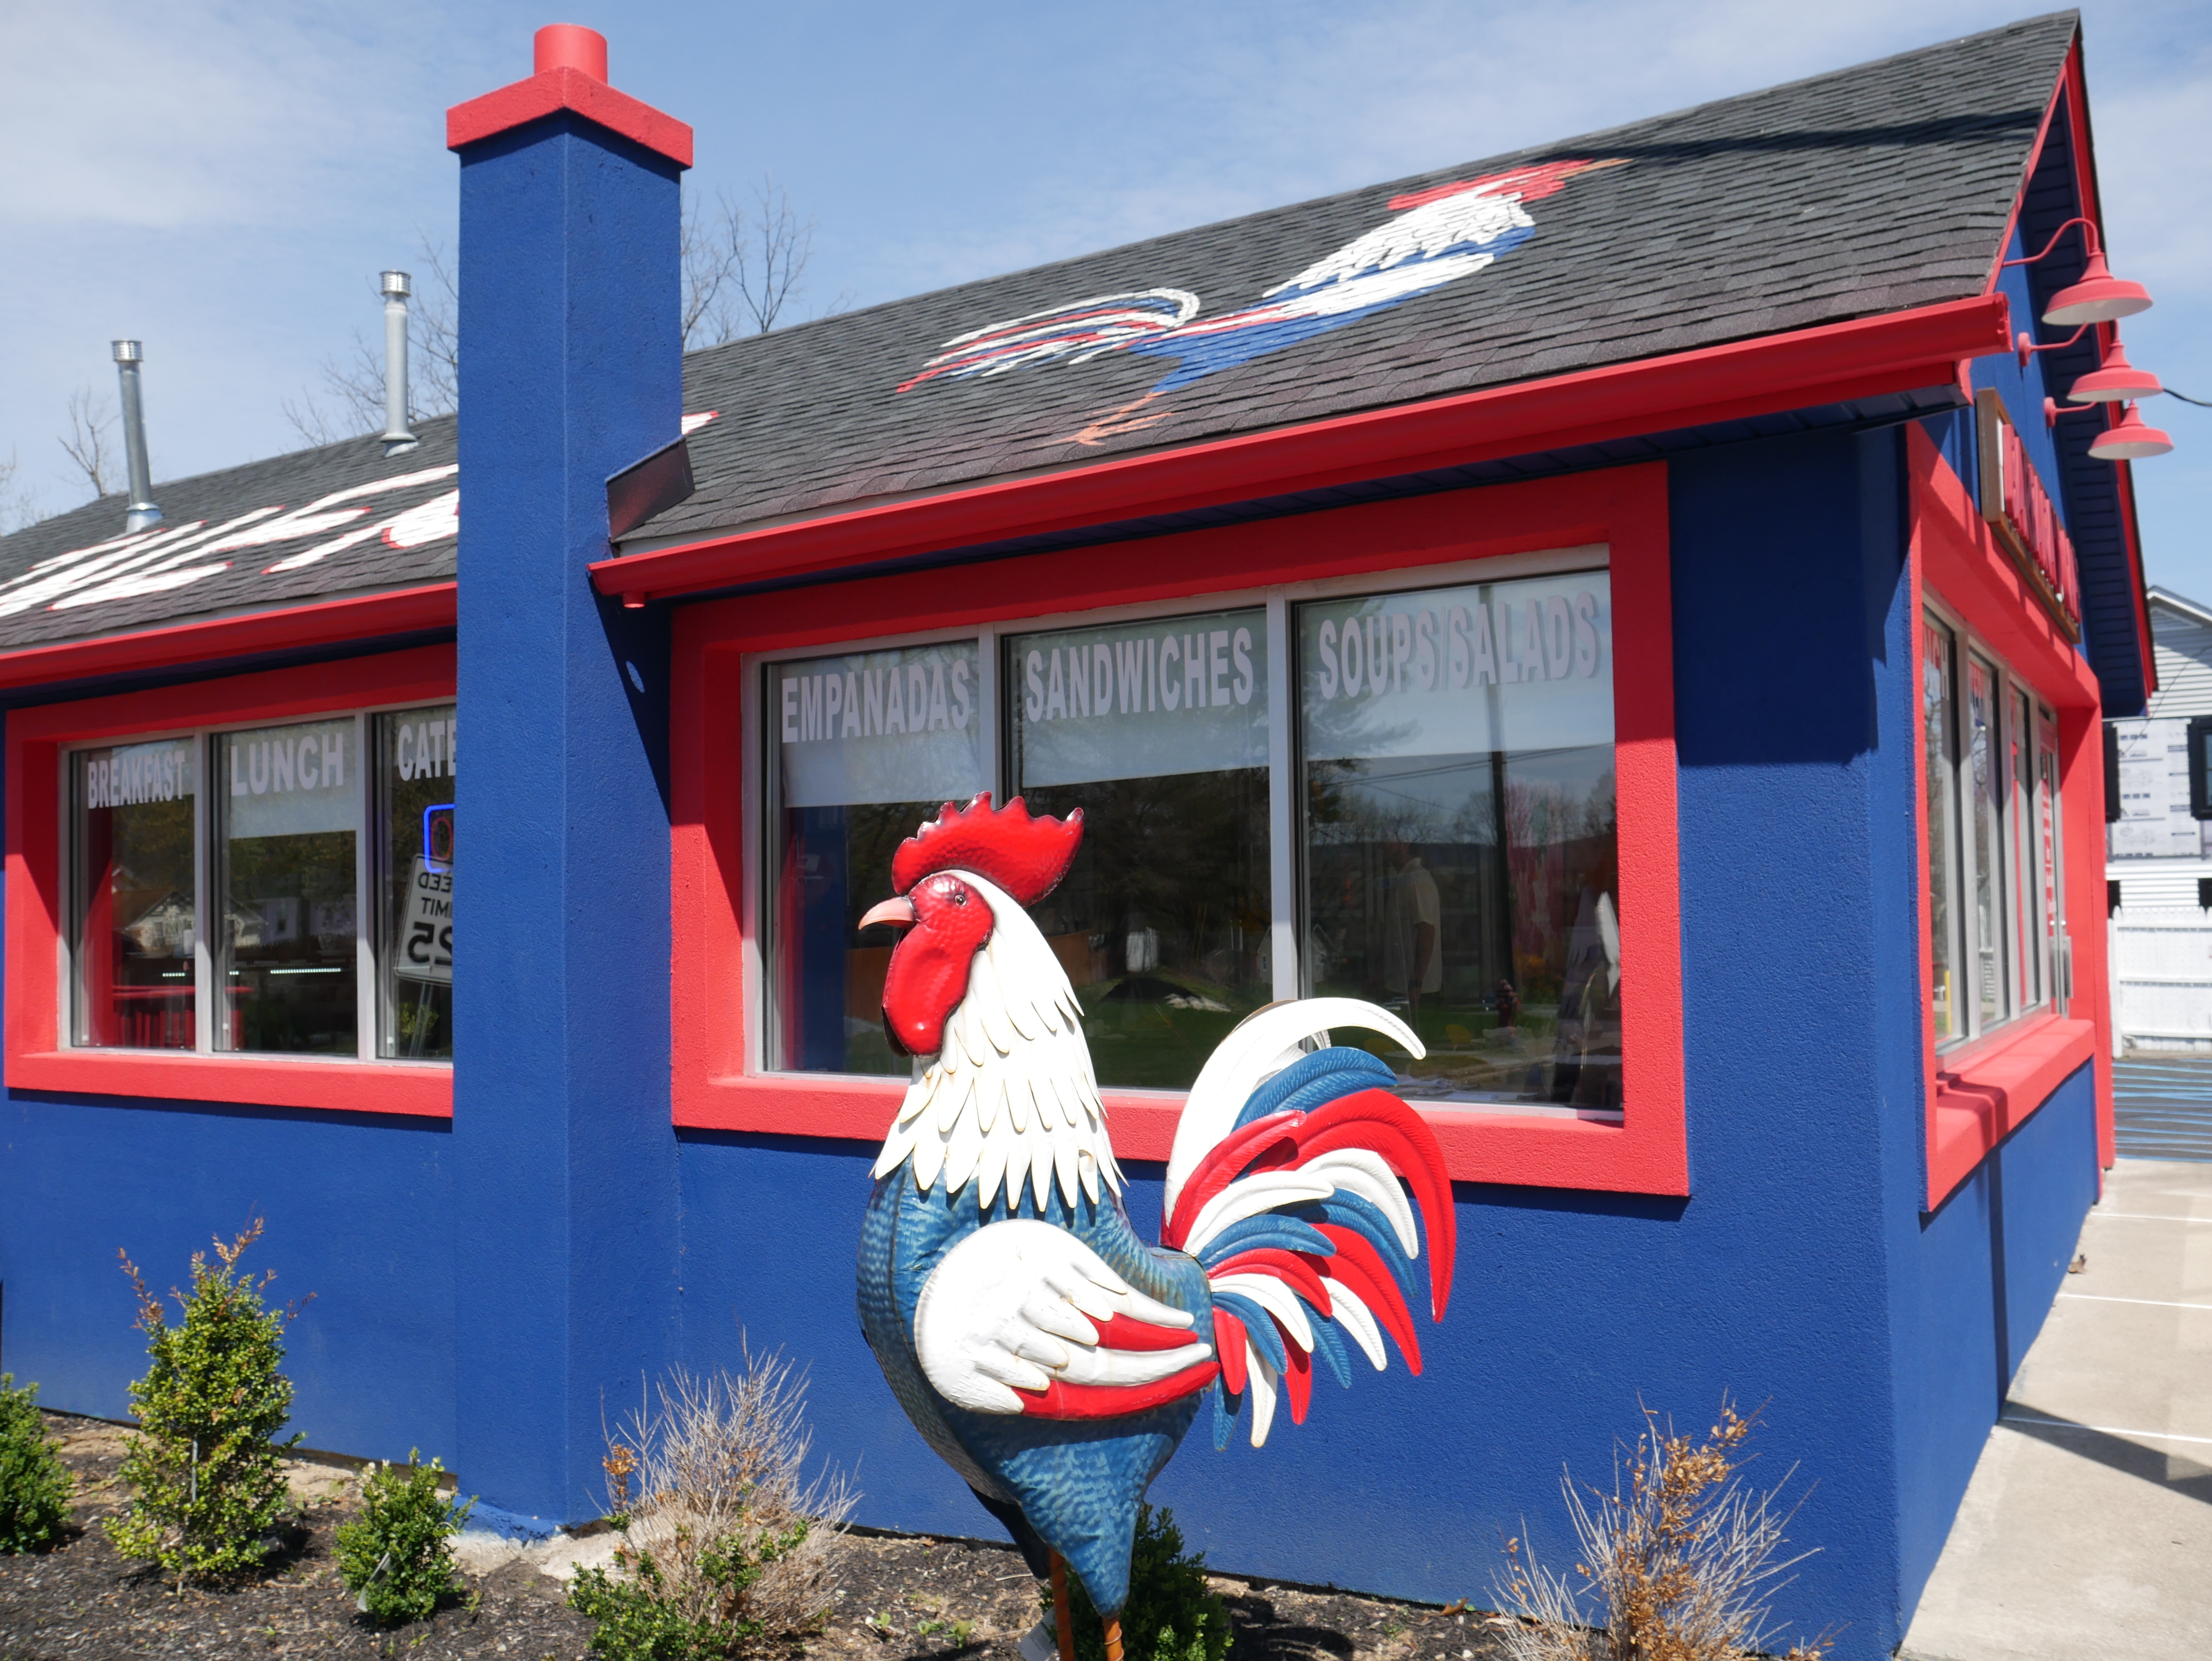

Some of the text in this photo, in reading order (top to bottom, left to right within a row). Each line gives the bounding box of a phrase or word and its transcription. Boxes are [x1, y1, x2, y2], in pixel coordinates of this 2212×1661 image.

[782, 659, 971, 743] EMPANADAS
[1026, 627, 1254, 723] SANDWICHES
[87, 750, 186, 809] BREAKFAST
[230, 732, 344, 797] LUNCH
